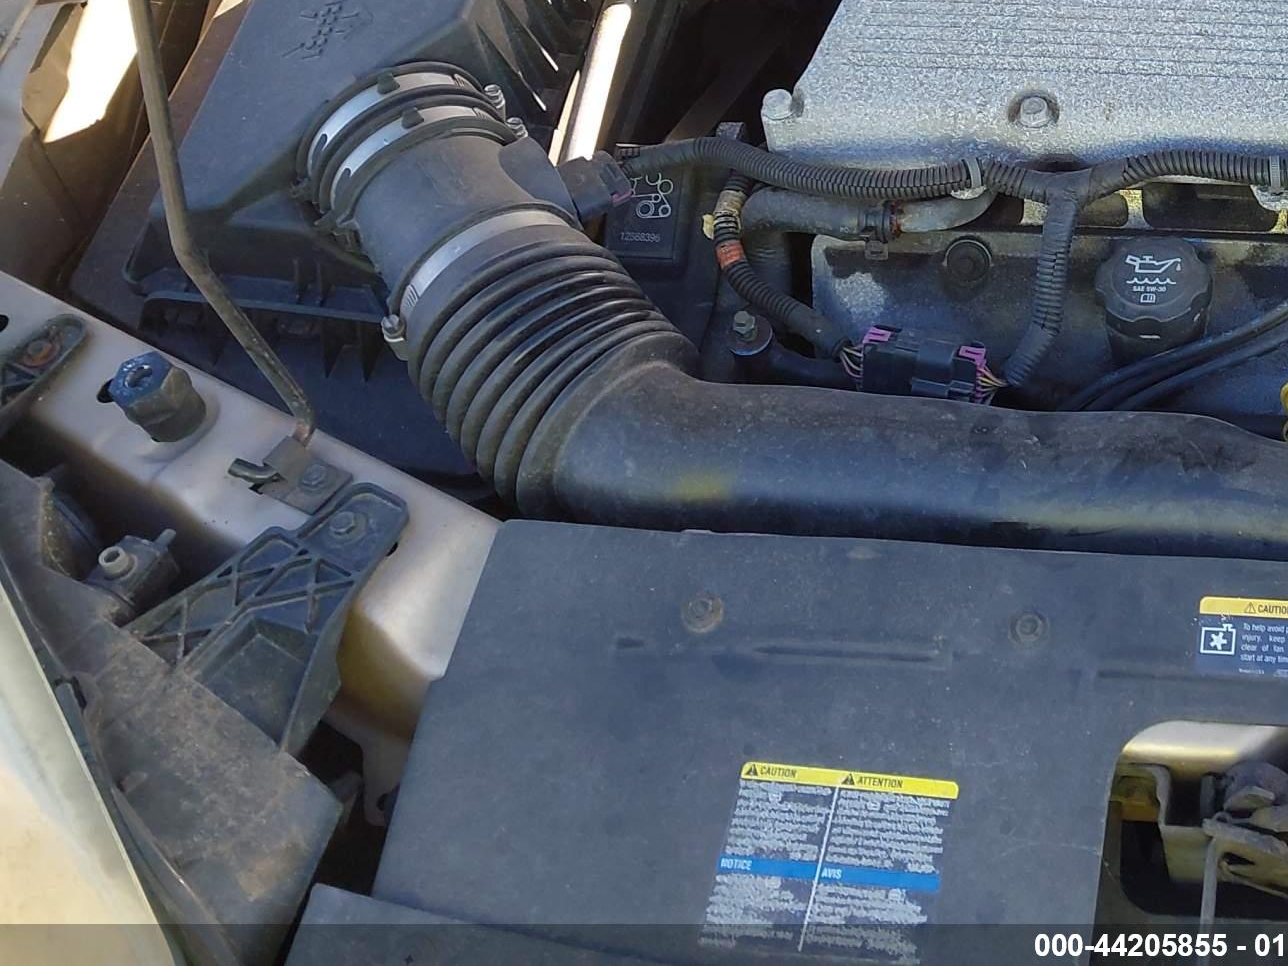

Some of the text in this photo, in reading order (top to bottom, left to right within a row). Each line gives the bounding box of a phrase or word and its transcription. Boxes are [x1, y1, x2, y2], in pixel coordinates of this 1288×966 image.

[1243, 622, 1251, 631] To
[1251, 623, 1266, 633] help
[1267, 625, 1285, 633] avoid
[1268, 634, 1285, 644] keep
[1240, 643, 1257, 651] clear
[1261, 644, 1269, 652] of
[1240, 654, 1255, 662] start
[1263, 656, 1276, 664] any
[760, 765, 797, 778] CAUTION
[856, 775, 903, 788] ATTENTION
[720, 856, 752, 871] NOTICE
[821, 867, 842, 880] AVIS
